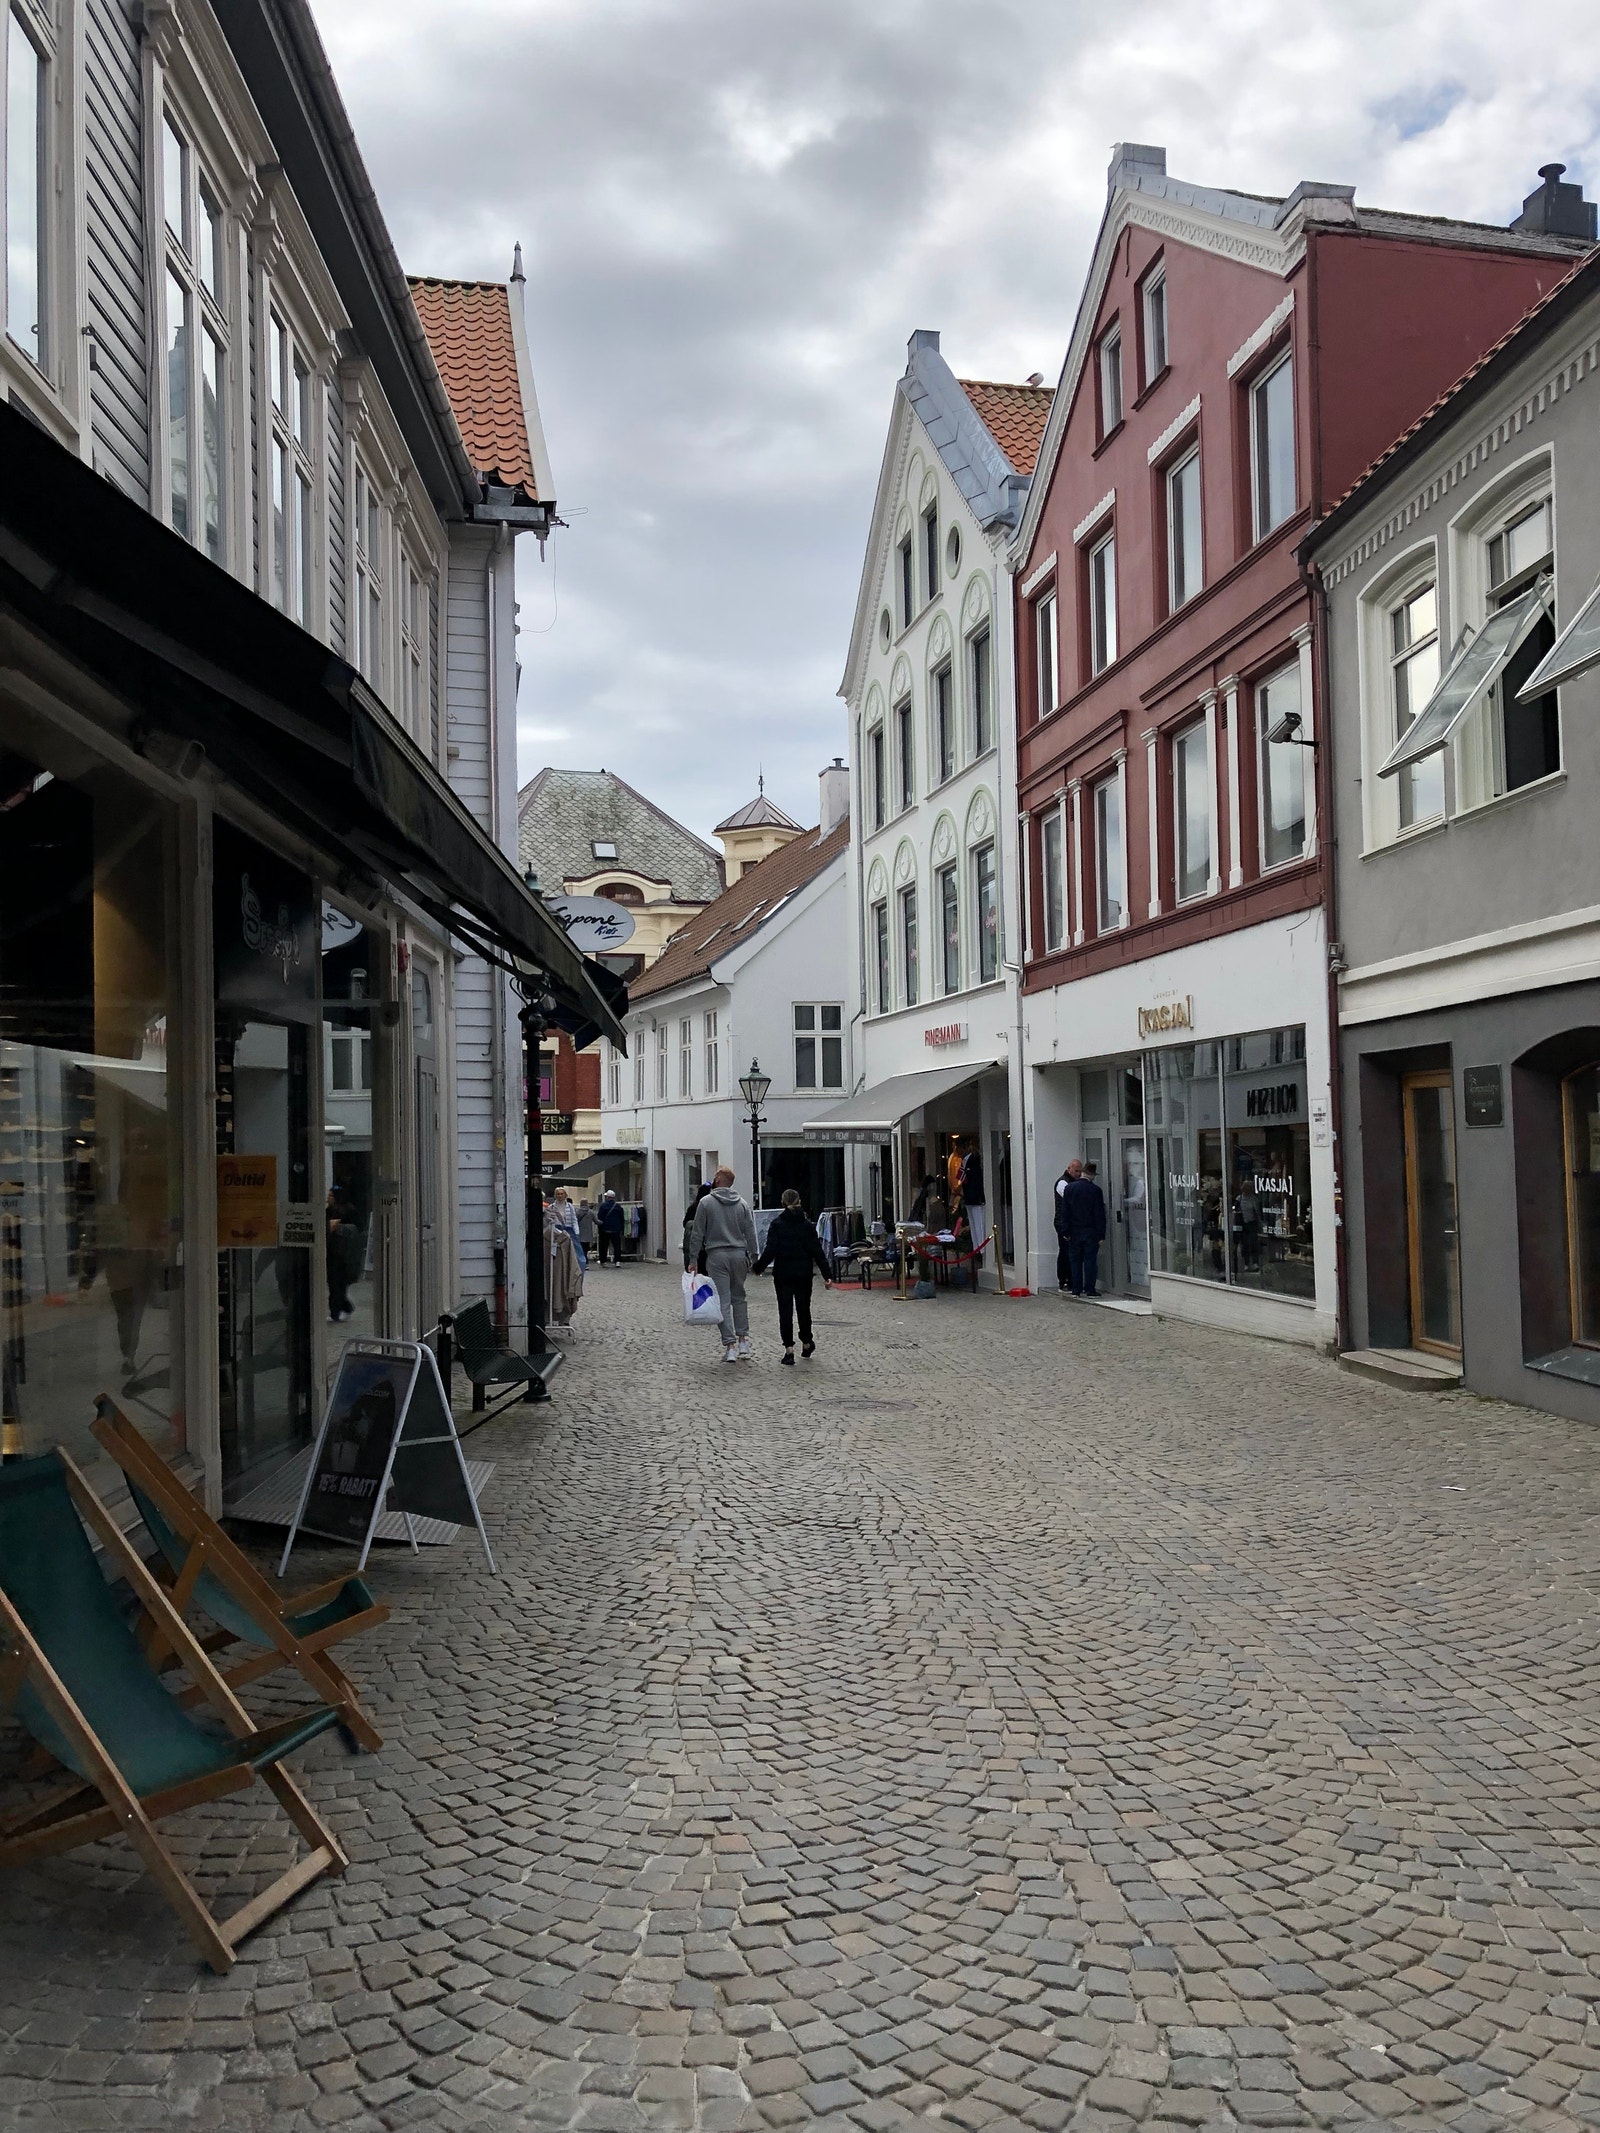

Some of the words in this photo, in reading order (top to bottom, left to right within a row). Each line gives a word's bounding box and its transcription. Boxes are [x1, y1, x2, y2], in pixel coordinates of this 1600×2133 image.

[1253, 1175, 1293, 1196] [KASJA]
[285, 1222, 313, 1230] OPEN
[338, 1476, 378, 1498] RABATT
